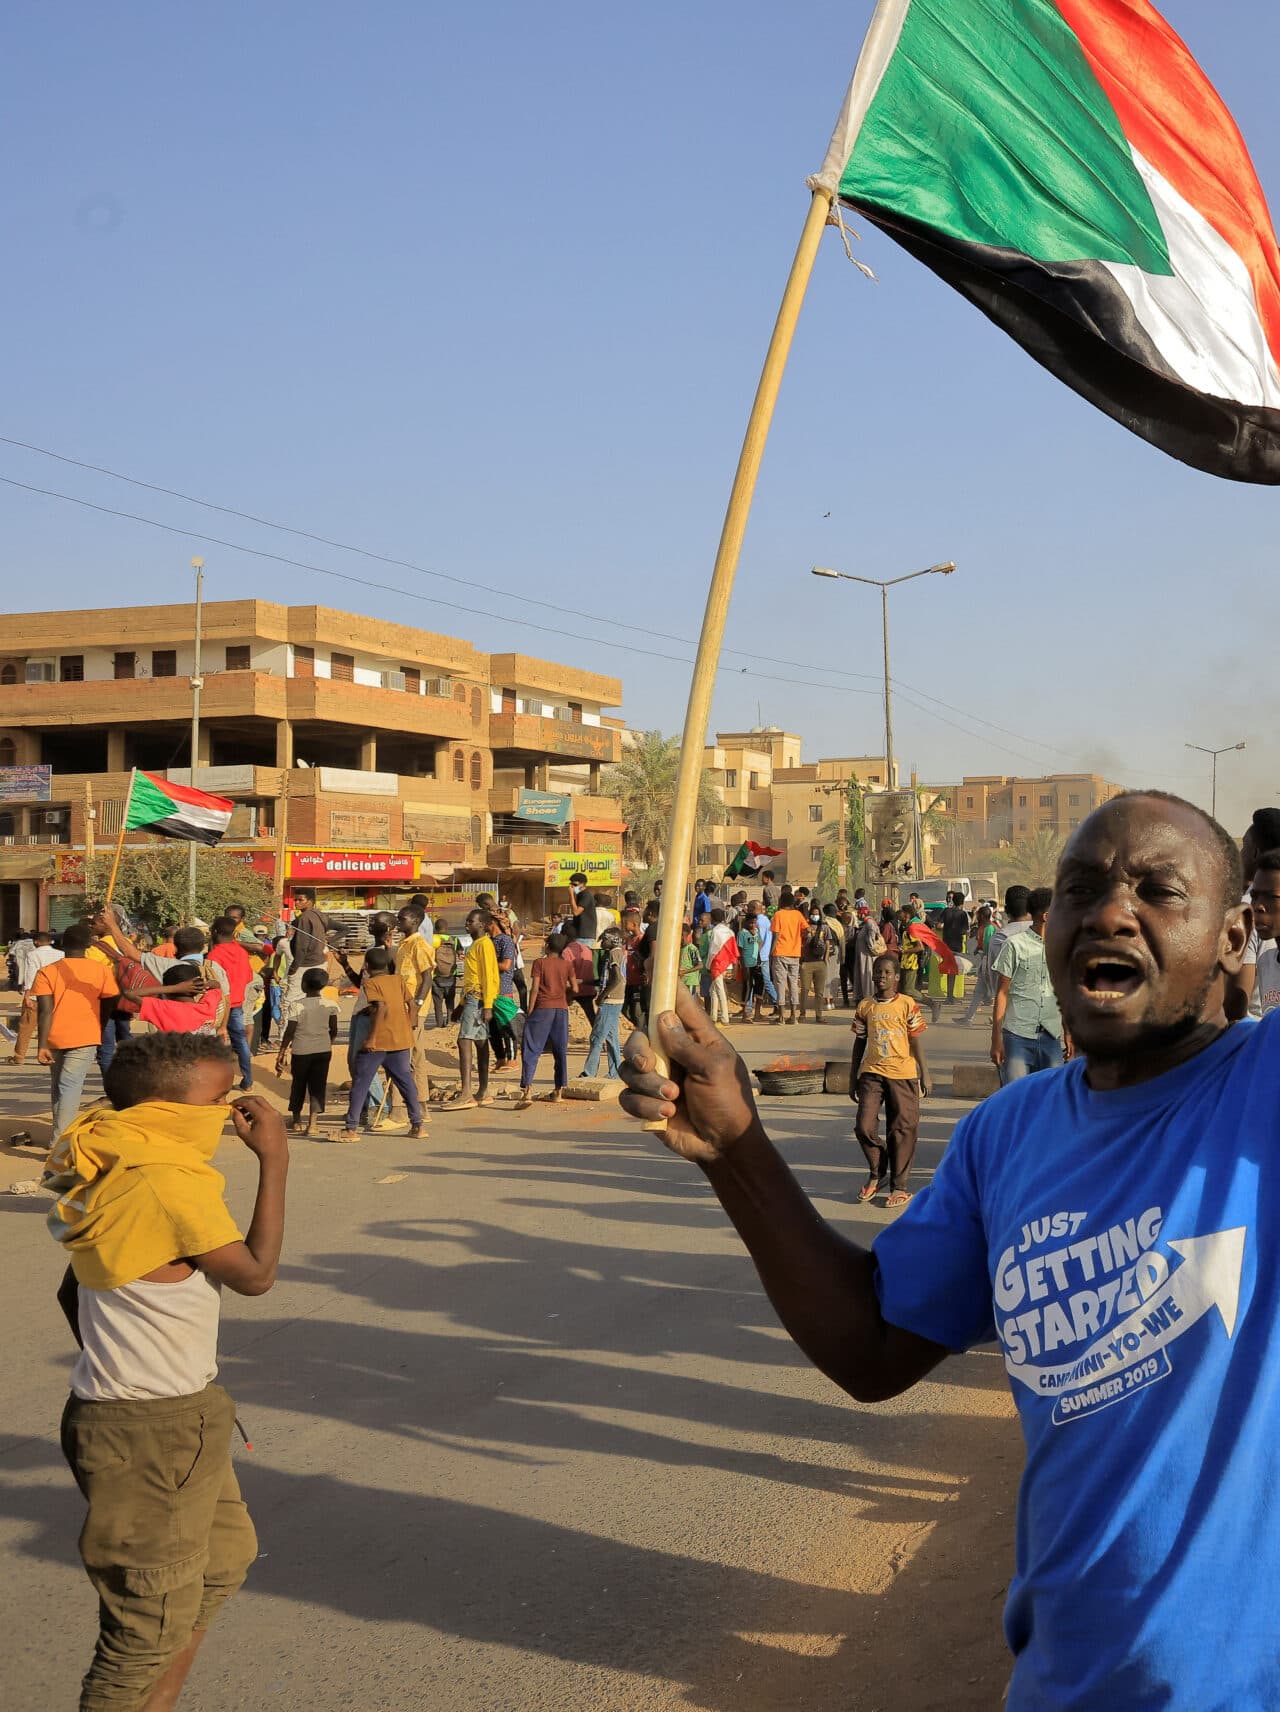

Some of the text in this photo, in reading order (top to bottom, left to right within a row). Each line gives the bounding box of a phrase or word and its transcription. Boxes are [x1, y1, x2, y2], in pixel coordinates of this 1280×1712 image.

[526, 807, 557, 815] Shoes
[326, 860, 386, 871] delicious
[1019, 1211, 1088, 1253] JUST
[995, 1206, 1163, 1312] GETTING
[1003, 1251, 1170, 1365] STARTED
[1060, 1357, 1158, 1414] SUMMER 2019
